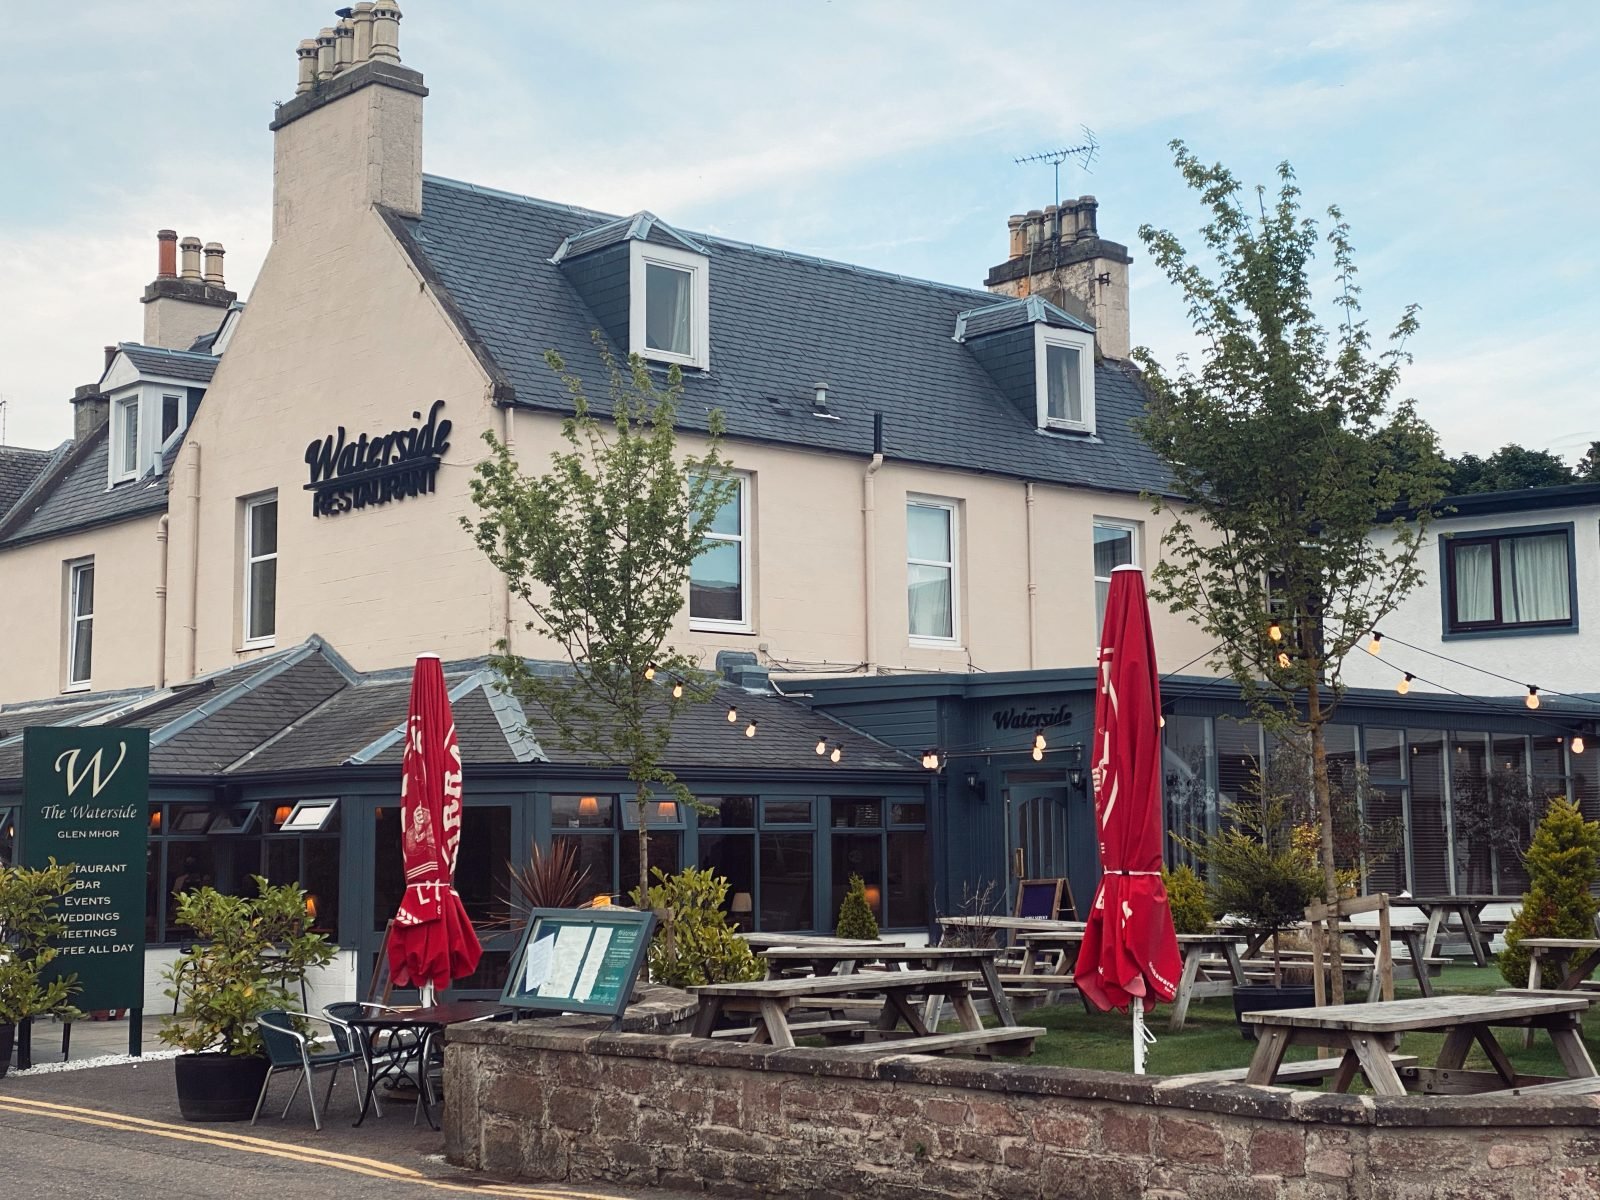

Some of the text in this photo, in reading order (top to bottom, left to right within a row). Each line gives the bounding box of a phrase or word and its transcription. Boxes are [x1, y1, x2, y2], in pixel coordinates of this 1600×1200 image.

[305, 400, 452, 484] Waterside
[313, 464, 438, 518] RESTAURANT
[993, 704, 1072, 729] Waterside
[55, 741, 126, 798] W
[41, 803, 137, 819] The Waterside
[57, 829, 120, 839] GLEN MHOR
[75, 880, 101, 890] BAR
[64, 896, 112, 906] EVENTS
[56, 943, 134, 957] FFEE ALL DAY
